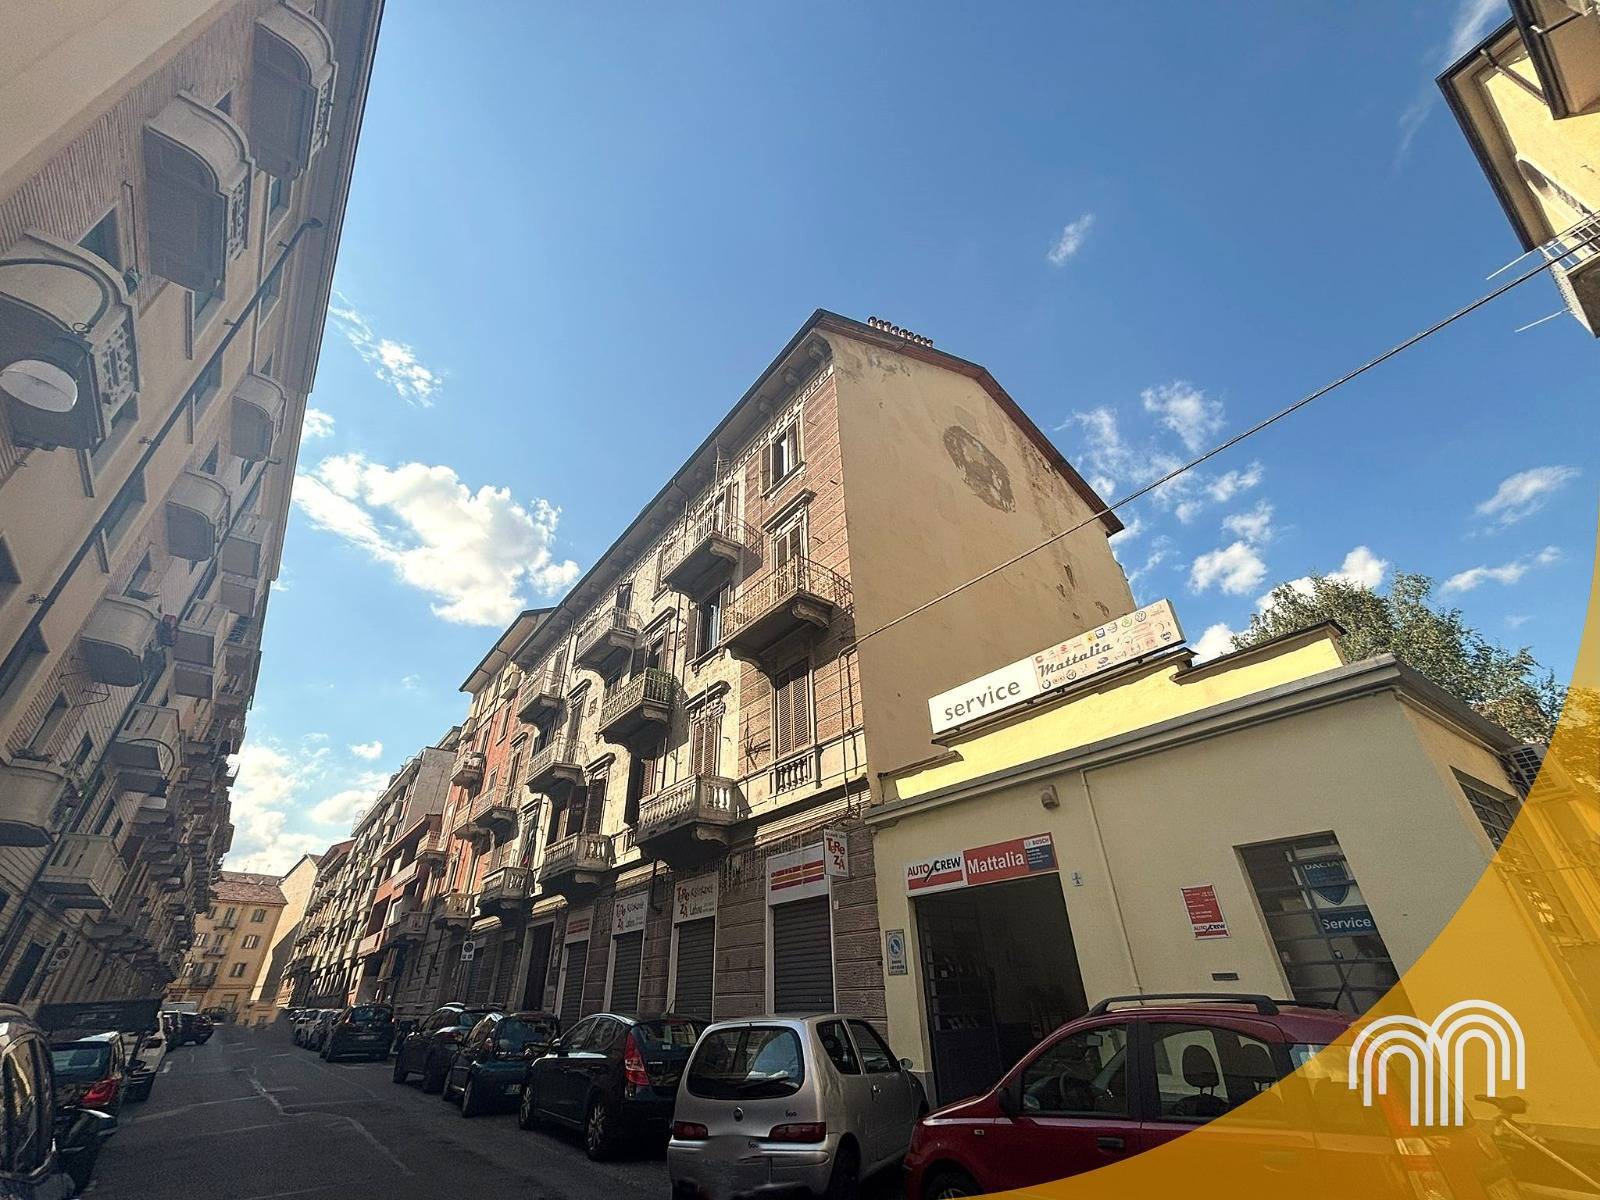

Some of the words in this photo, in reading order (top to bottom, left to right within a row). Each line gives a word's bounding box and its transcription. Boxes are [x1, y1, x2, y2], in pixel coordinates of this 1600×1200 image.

[1038, 642, 1114, 678] Mattalia
[944, 679, 1022, 721] service
[967, 851, 1025, 875] Mattalia
[1322, 917, 1372, 930] Service
